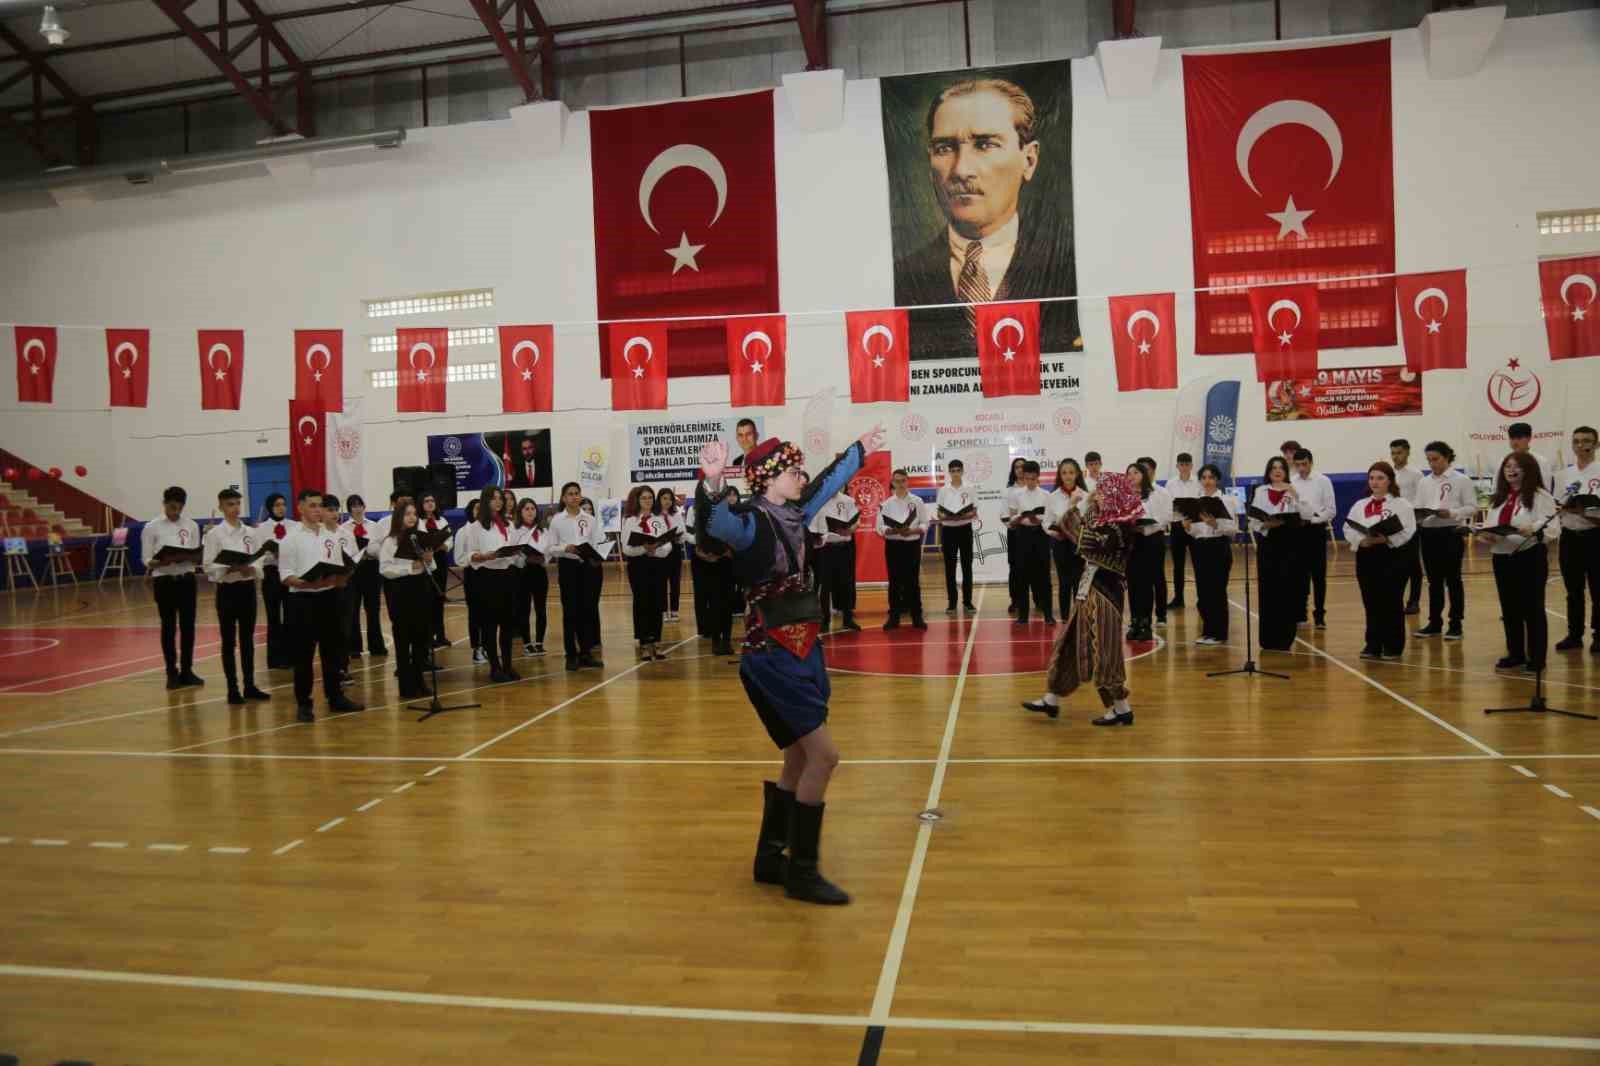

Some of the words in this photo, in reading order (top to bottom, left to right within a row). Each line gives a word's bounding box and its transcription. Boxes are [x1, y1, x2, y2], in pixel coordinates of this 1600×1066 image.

[911, 368, 930, 379] BEN
[1052, 362, 1064, 372] VE
[1314, 370, 1328, 385] 9
[1332, 369, 1383, 384] MAYIS
[922, 383, 970, 395] ZAMANDA
[643, 433, 719, 446] SPORCULARIMIZA
[640, 447, 651, 456] VE
